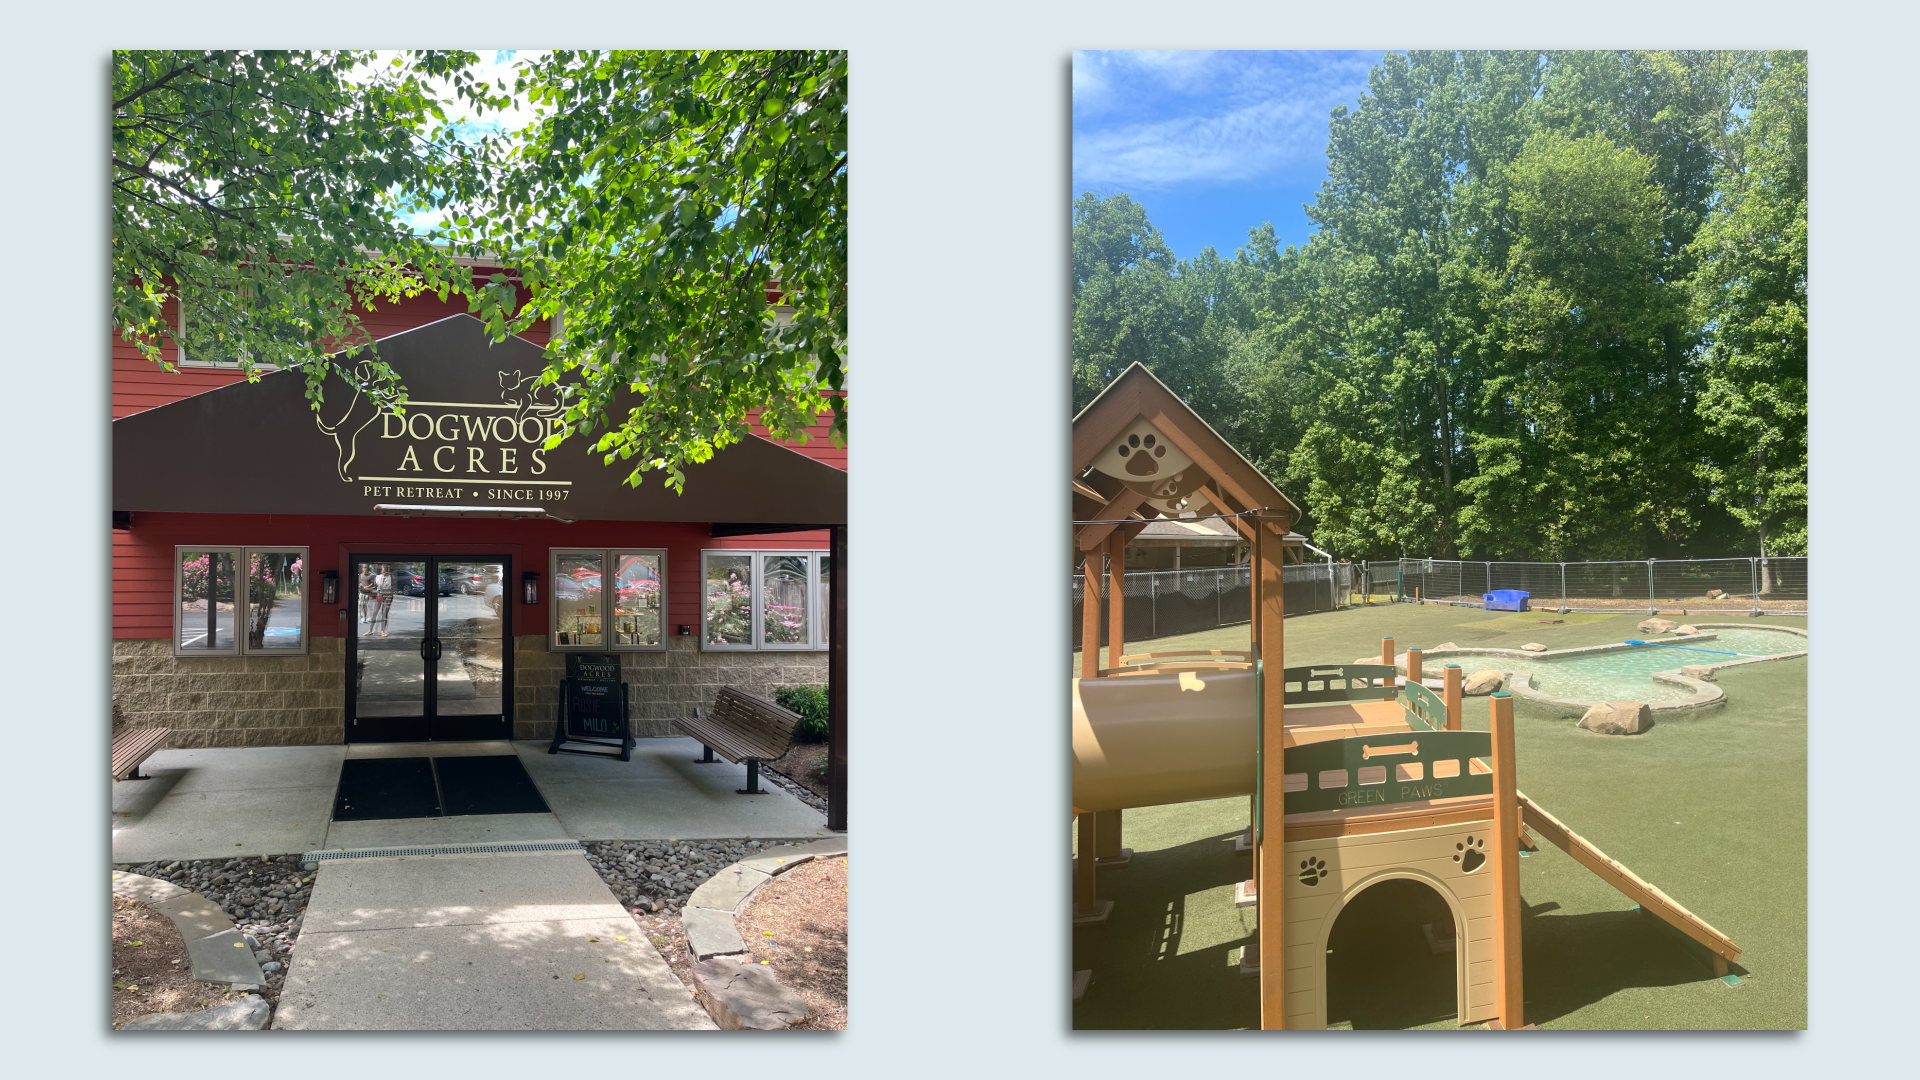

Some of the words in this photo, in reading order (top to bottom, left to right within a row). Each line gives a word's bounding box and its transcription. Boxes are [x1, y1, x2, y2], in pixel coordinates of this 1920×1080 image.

[380, 412, 568, 443] DOGWOOD
[396, 445, 547, 475] ACRES
[363, 485, 392, 498] PET
[396, 486, 463, 499] RETREAT
[487, 488, 534, 500] SINCE
[538, 489, 570, 501] 1997
[583, 718, 607, 732] MILO
[1338, 788, 1385, 806] GREEN
[1401, 783, 1443, 800] PAWS
